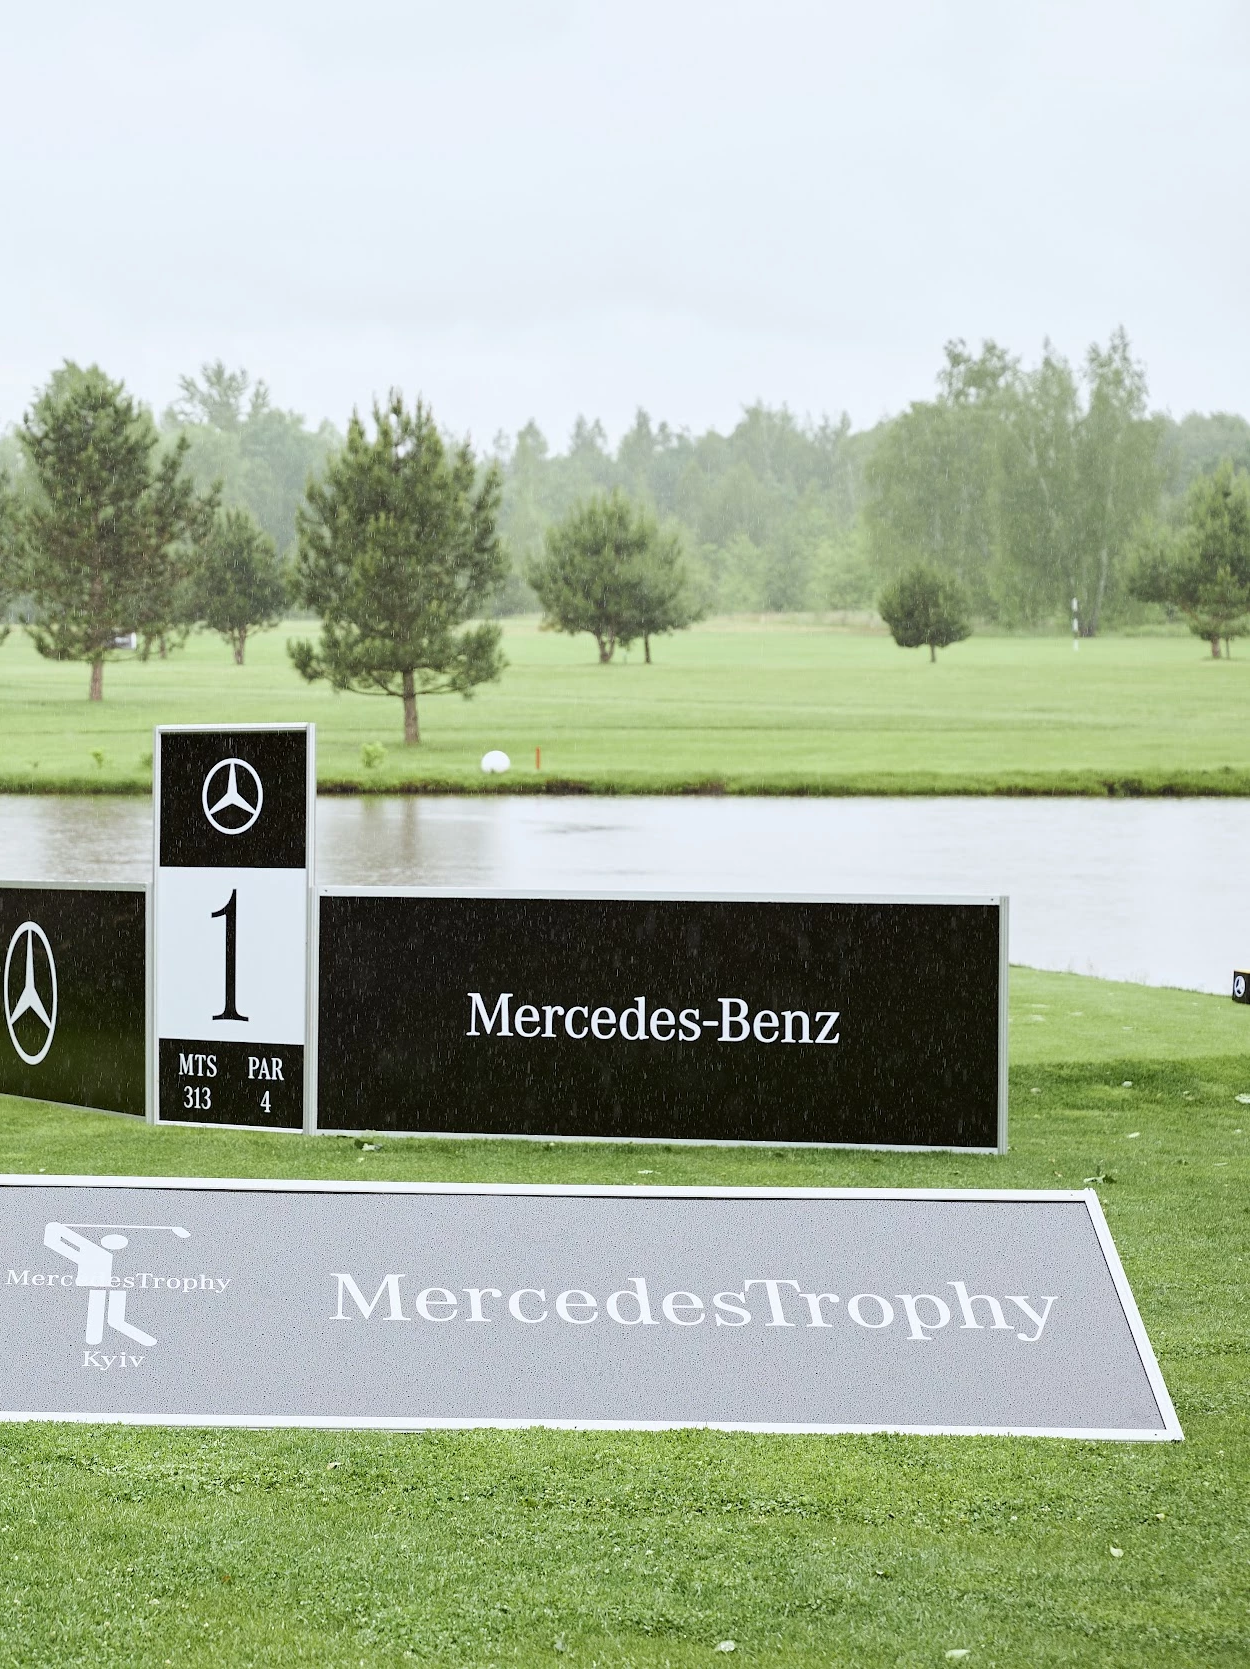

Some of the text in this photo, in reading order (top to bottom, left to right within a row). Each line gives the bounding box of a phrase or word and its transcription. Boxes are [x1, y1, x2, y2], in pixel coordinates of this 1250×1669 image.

[211, 888, 249, 1021] 1
[466, 992, 840, 1044] Mercedes-Benz
[178, 1053, 218, 1077] MTS
[248, 1056, 285, 1080] PAR
[183, 1085, 211, 1110] 313
[260, 1090, 271, 1113] 4
[4, 1269, 232, 1294] MercesTrophy
[329, 1273, 1059, 1342] MercedesTrophy
[81, 1351, 146, 1371] Kyiv
